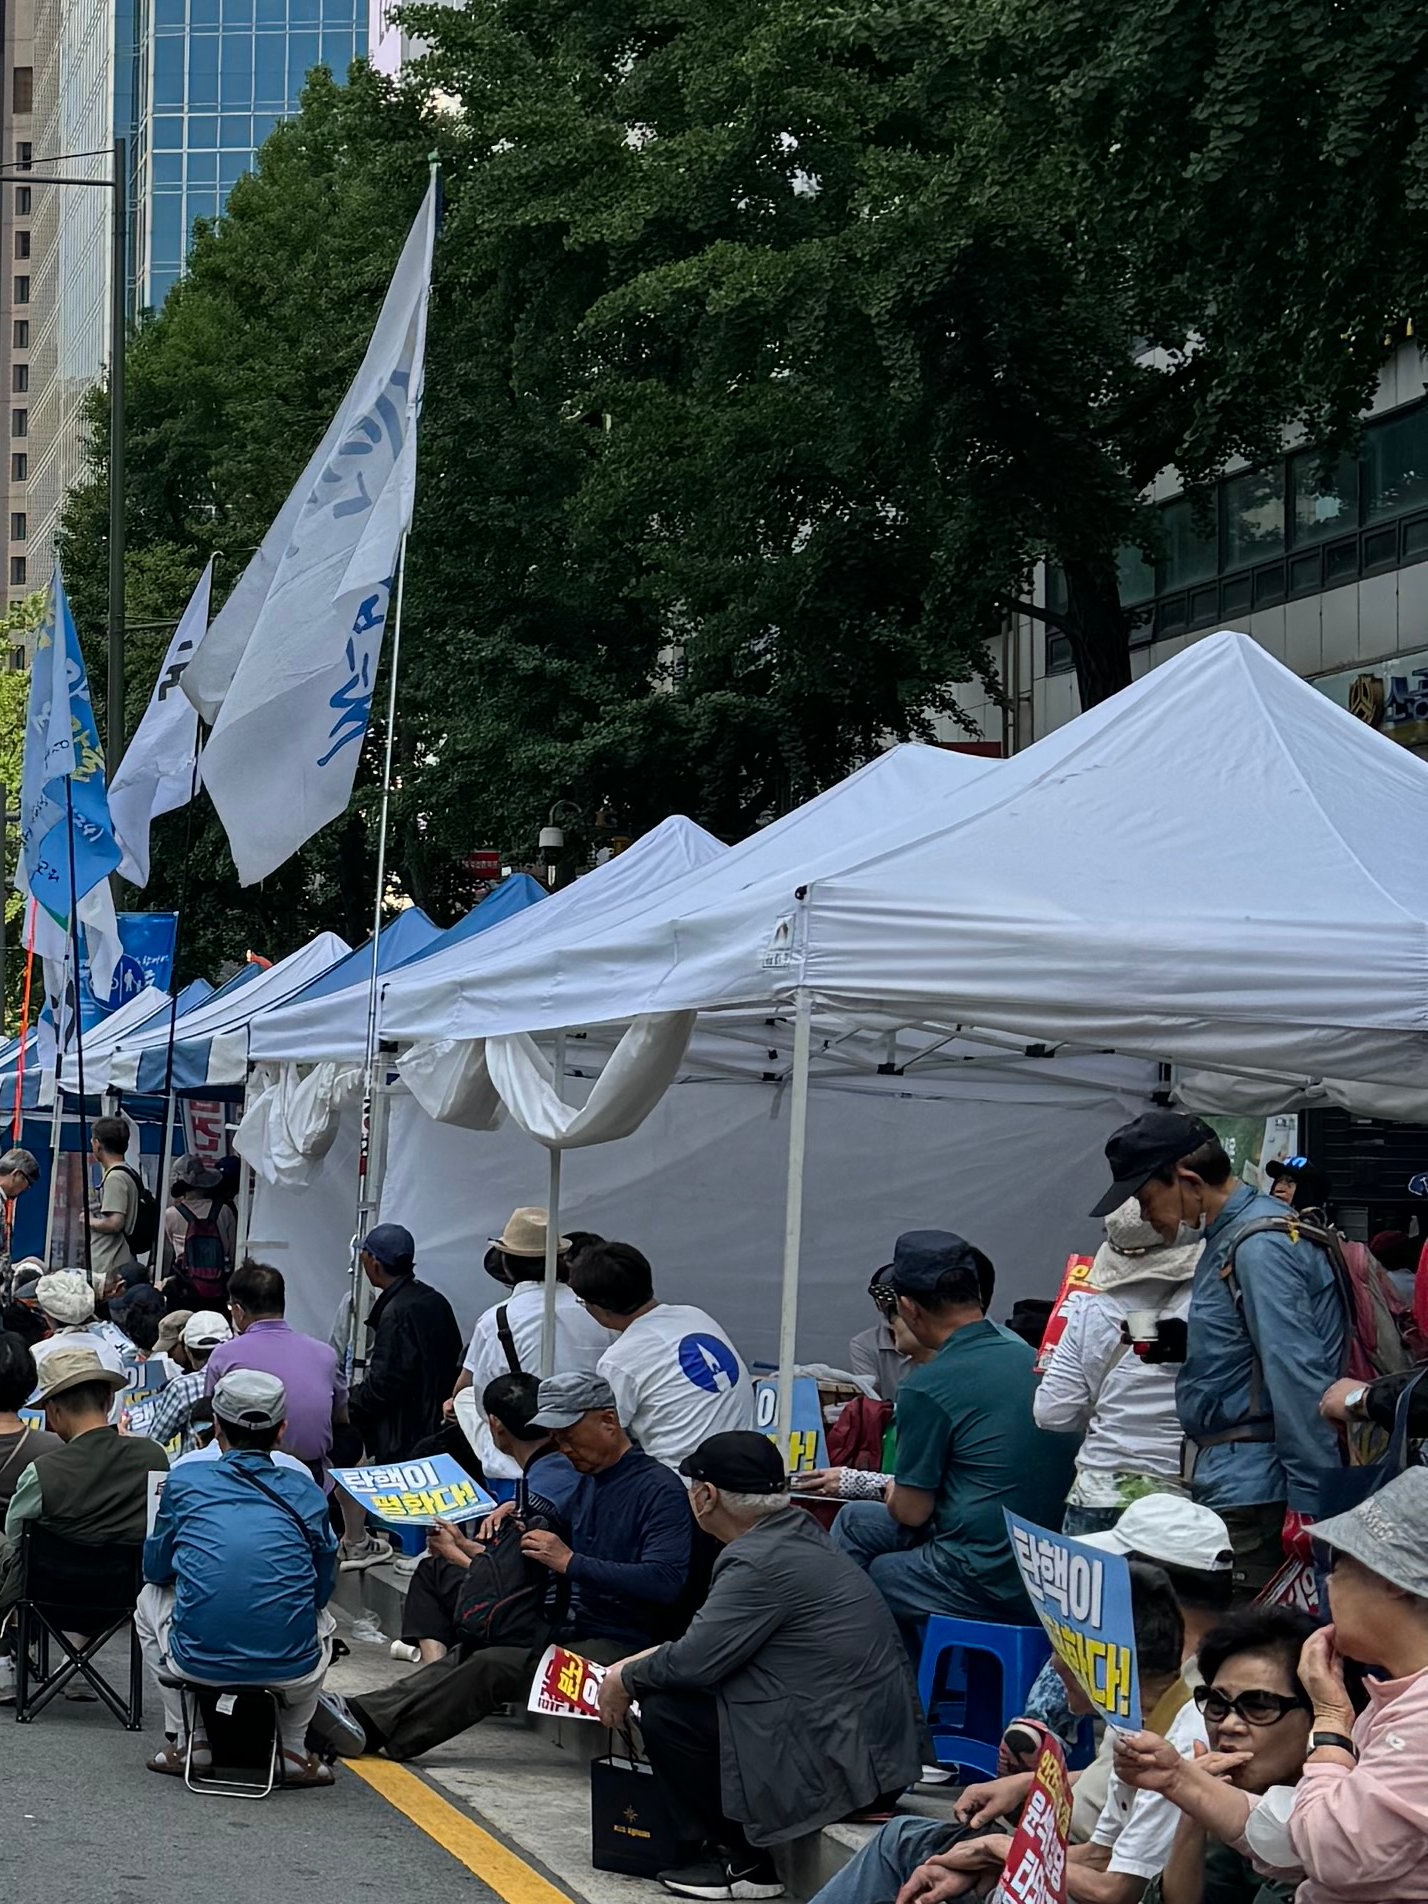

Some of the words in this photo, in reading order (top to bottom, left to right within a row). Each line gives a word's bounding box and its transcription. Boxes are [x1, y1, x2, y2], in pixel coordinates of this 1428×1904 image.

[343, 1461, 440, 1494] 탄핵이
[371, 1480, 480, 1517] 평화다!
[1013, 1525, 1103, 1628] 탄핵이
